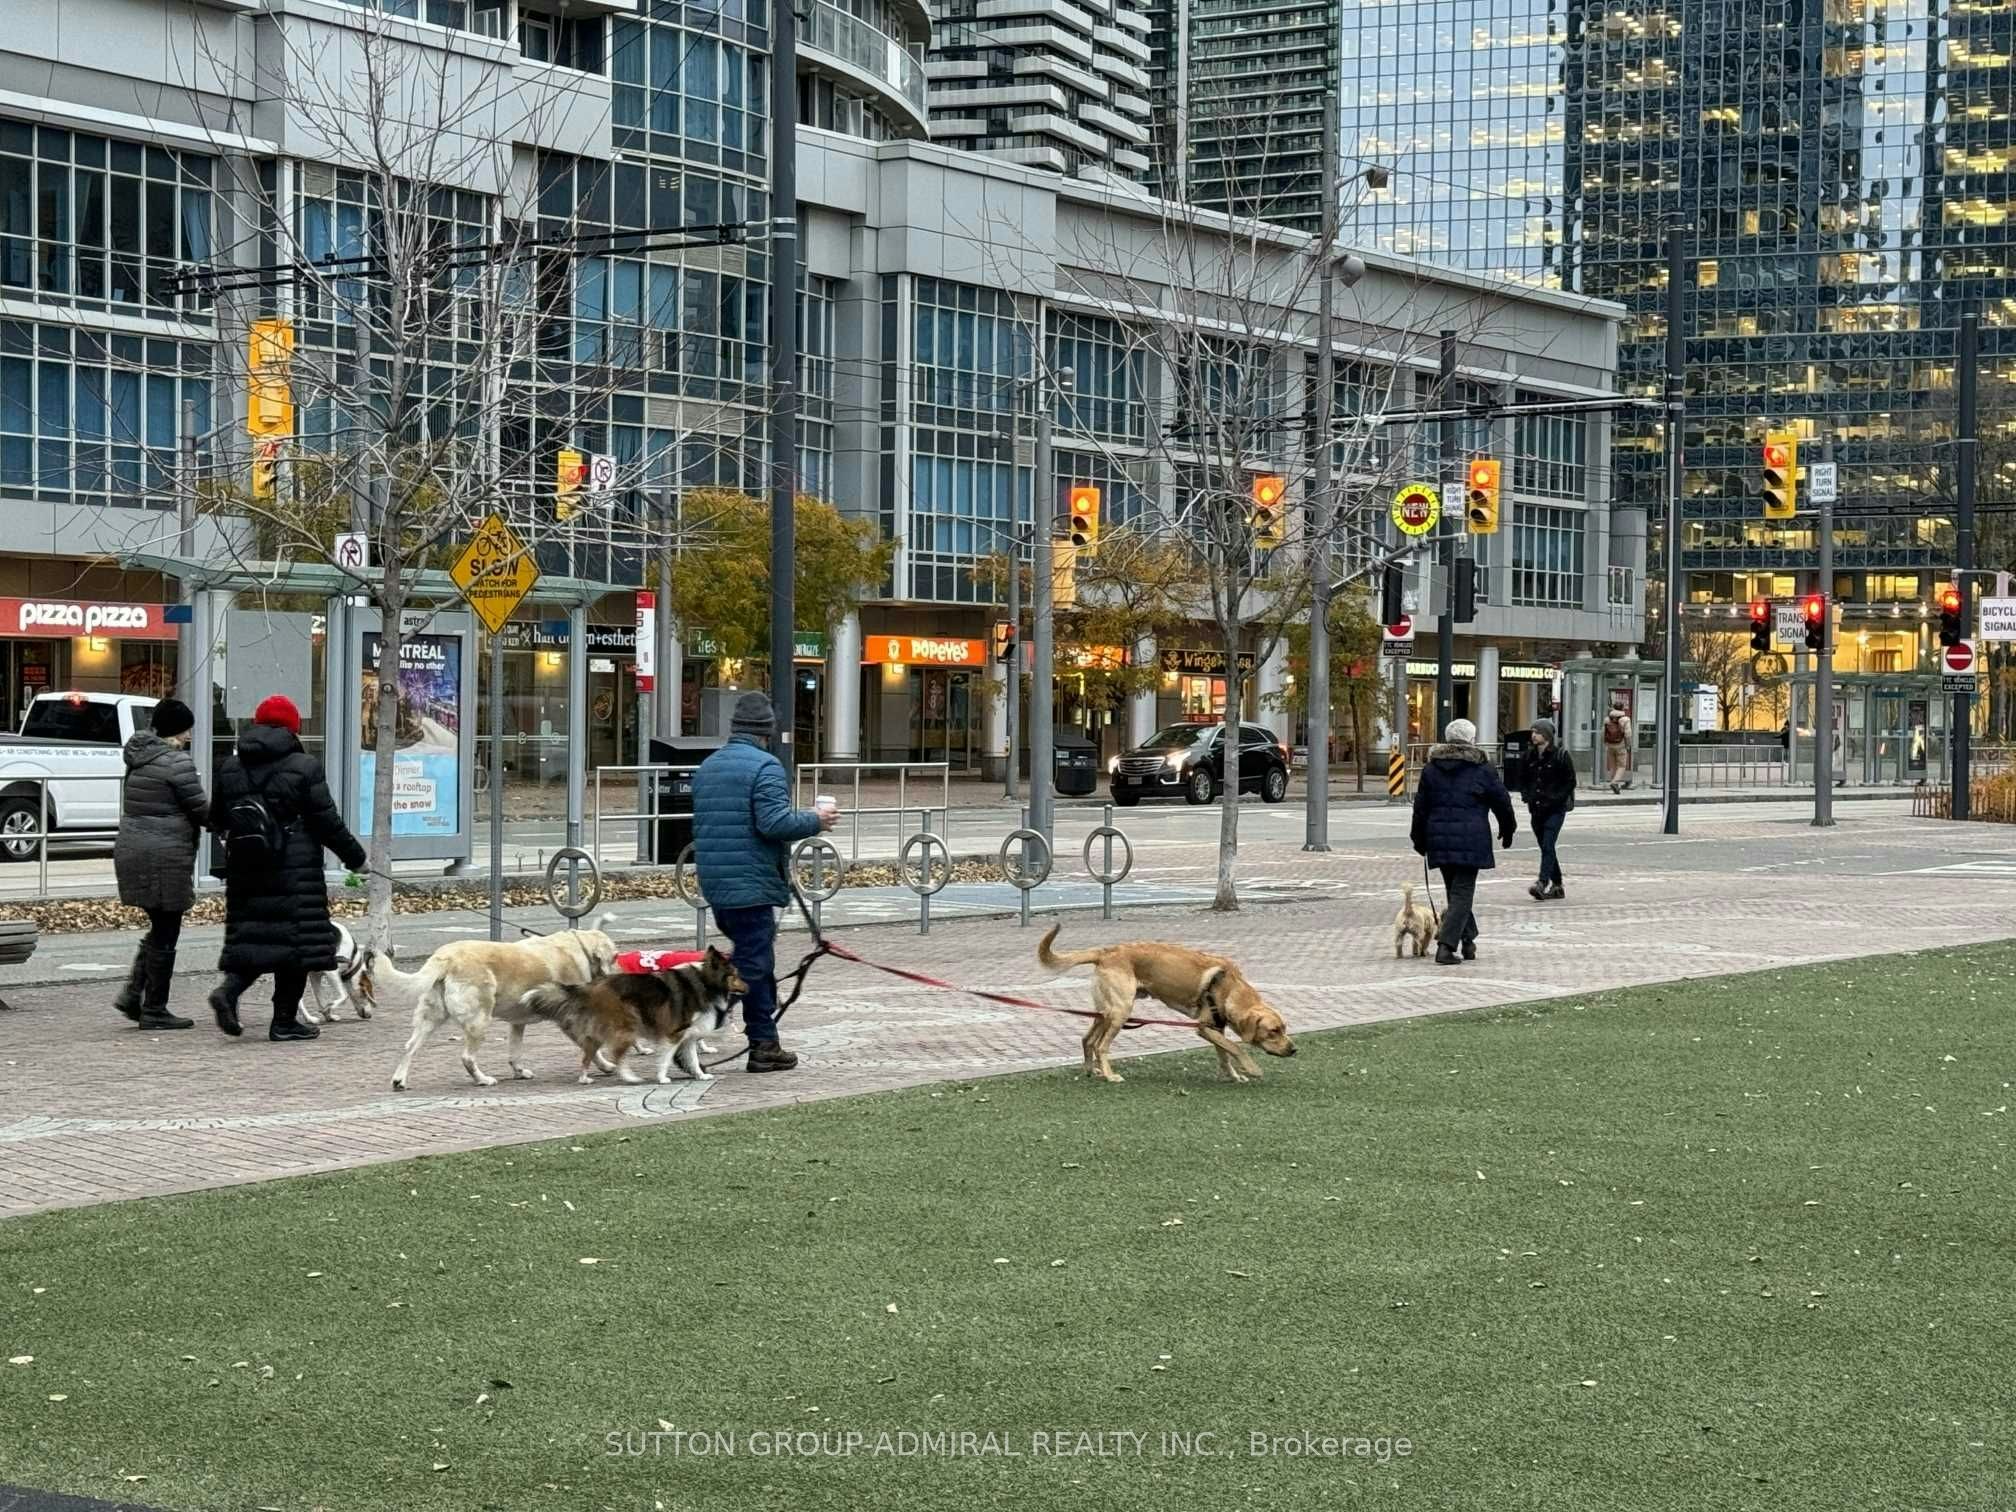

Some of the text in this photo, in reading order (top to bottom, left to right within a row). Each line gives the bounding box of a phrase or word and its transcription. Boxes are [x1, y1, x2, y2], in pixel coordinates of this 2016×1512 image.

[1814, 467, 1832, 477] RIGHT
[1816, 478, 1832, 487] TURN
[1812, 488, 1833, 497] SIGNAL
[1402, 503, 1428, 518] NEW
[469, 589, 520, 598] PEDESTRIANS
[1983, 606, 2016, 617] BICYCL
[19, 603, 148, 634] pizza pizza
[1779, 612, 1807, 624] TRANS
[1984, 622, 2016, 632] SIGNAL
[1780, 628, 1804, 639] SIGNA
[372, 641, 446, 660] MNTRÉAL
[414, 662, 425, 670] no
[1451, 664, 1476, 677] OFFEE
[1501, 666, 1544, 679] STARBUCKS
[403, 781, 432, 793] rooftop
[393, 800, 432, 810] the snow
